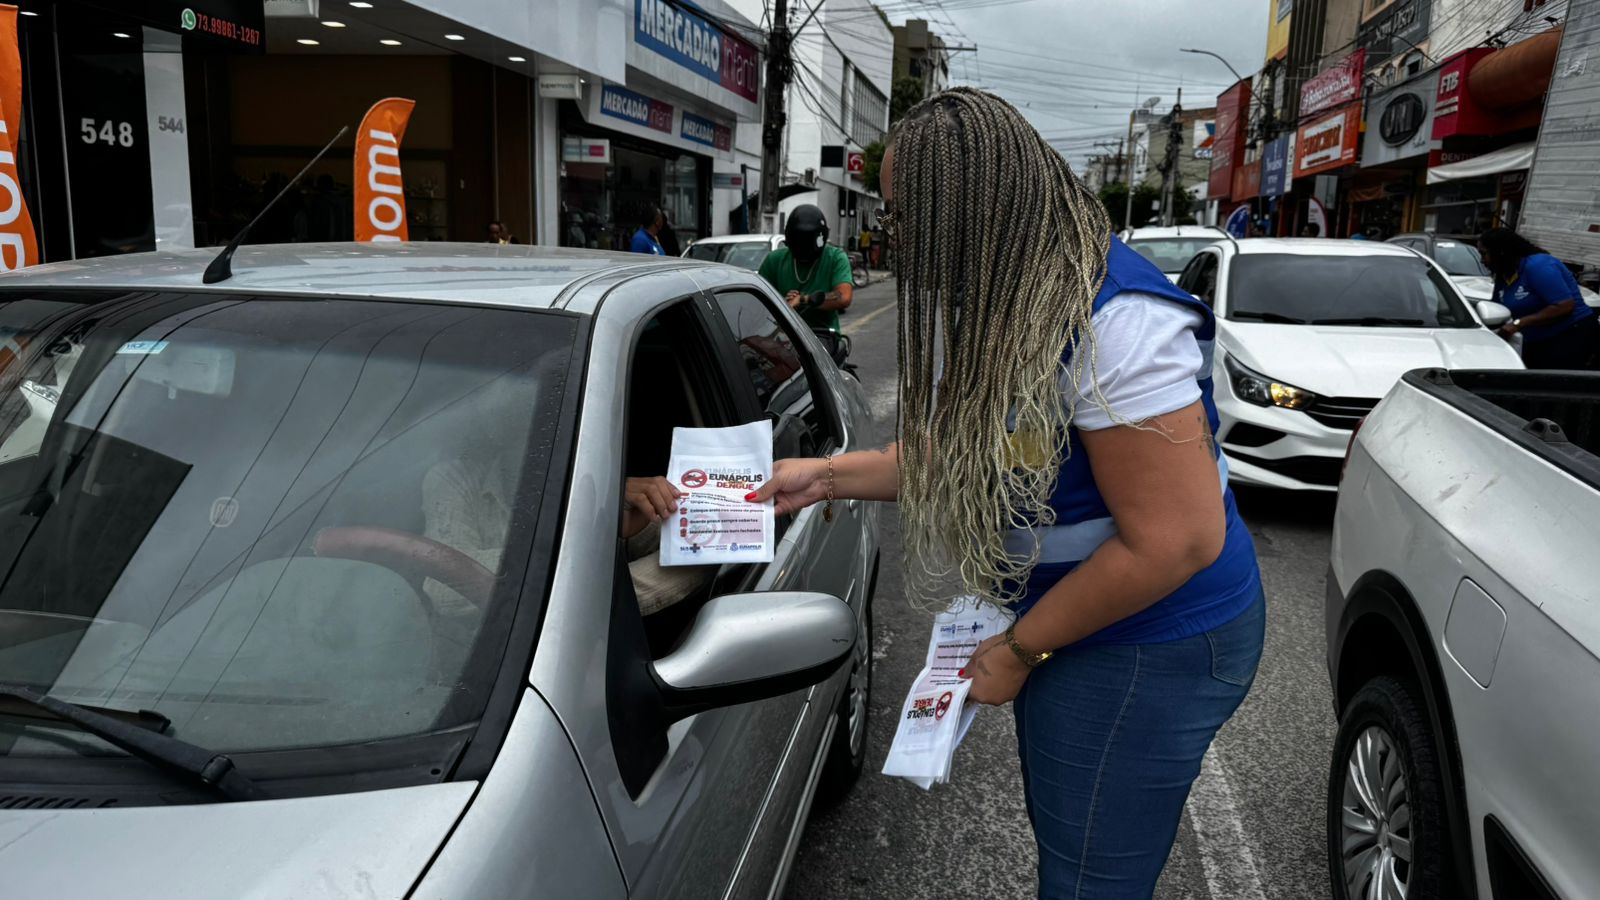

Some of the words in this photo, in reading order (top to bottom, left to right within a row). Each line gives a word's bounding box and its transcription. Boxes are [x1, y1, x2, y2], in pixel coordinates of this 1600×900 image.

[640, 0, 720, 72] MERCADÃO
[603, 92, 648, 121] MERCADÃO
[81, 117, 134, 148] 548
[158, 115, 184, 134] 544
[682, 119, 714, 143] MERCADÃO
[709, 473, 763, 483] EUNÁPOLIS
[716, 481, 755, 490] DENGUE
